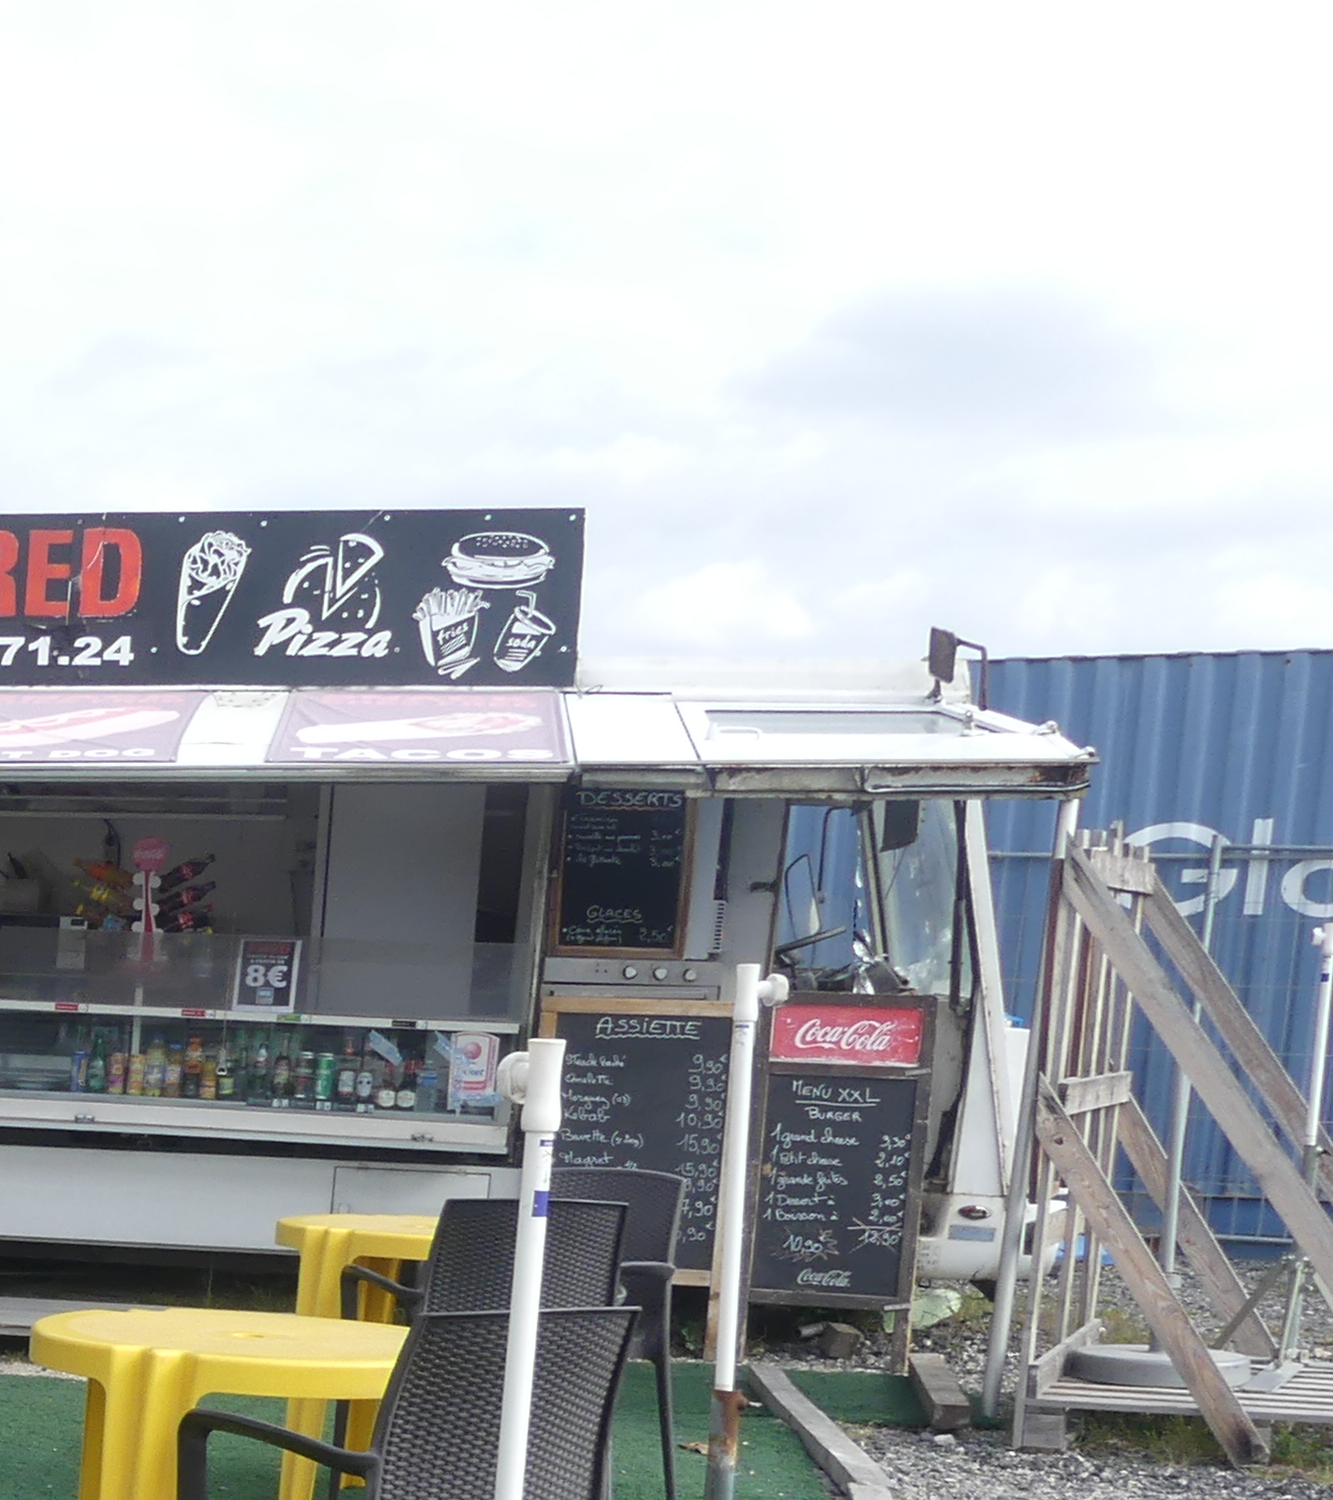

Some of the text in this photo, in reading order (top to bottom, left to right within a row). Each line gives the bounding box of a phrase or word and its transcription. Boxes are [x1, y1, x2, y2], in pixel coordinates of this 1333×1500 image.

[254, 607, 393, 657] Pizza
[436, 621, 469, 645] fries
[505, 633, 536, 649] soda
[48, 748, 157, 758] DOG
[288, 746, 554, 760] TACOS
[576, 791, 682, 808] DESSERTS
[586, 904, 643, 920] GLACES
[245, 964, 289, 988] 8€
[794, 1018, 897, 1051] Coca-Cola
[792, 1079, 881, 1103] MENU XXL
[563, 1105, 611, 1123] Kebab
[805, 1106, 863, 1123] BURGER
